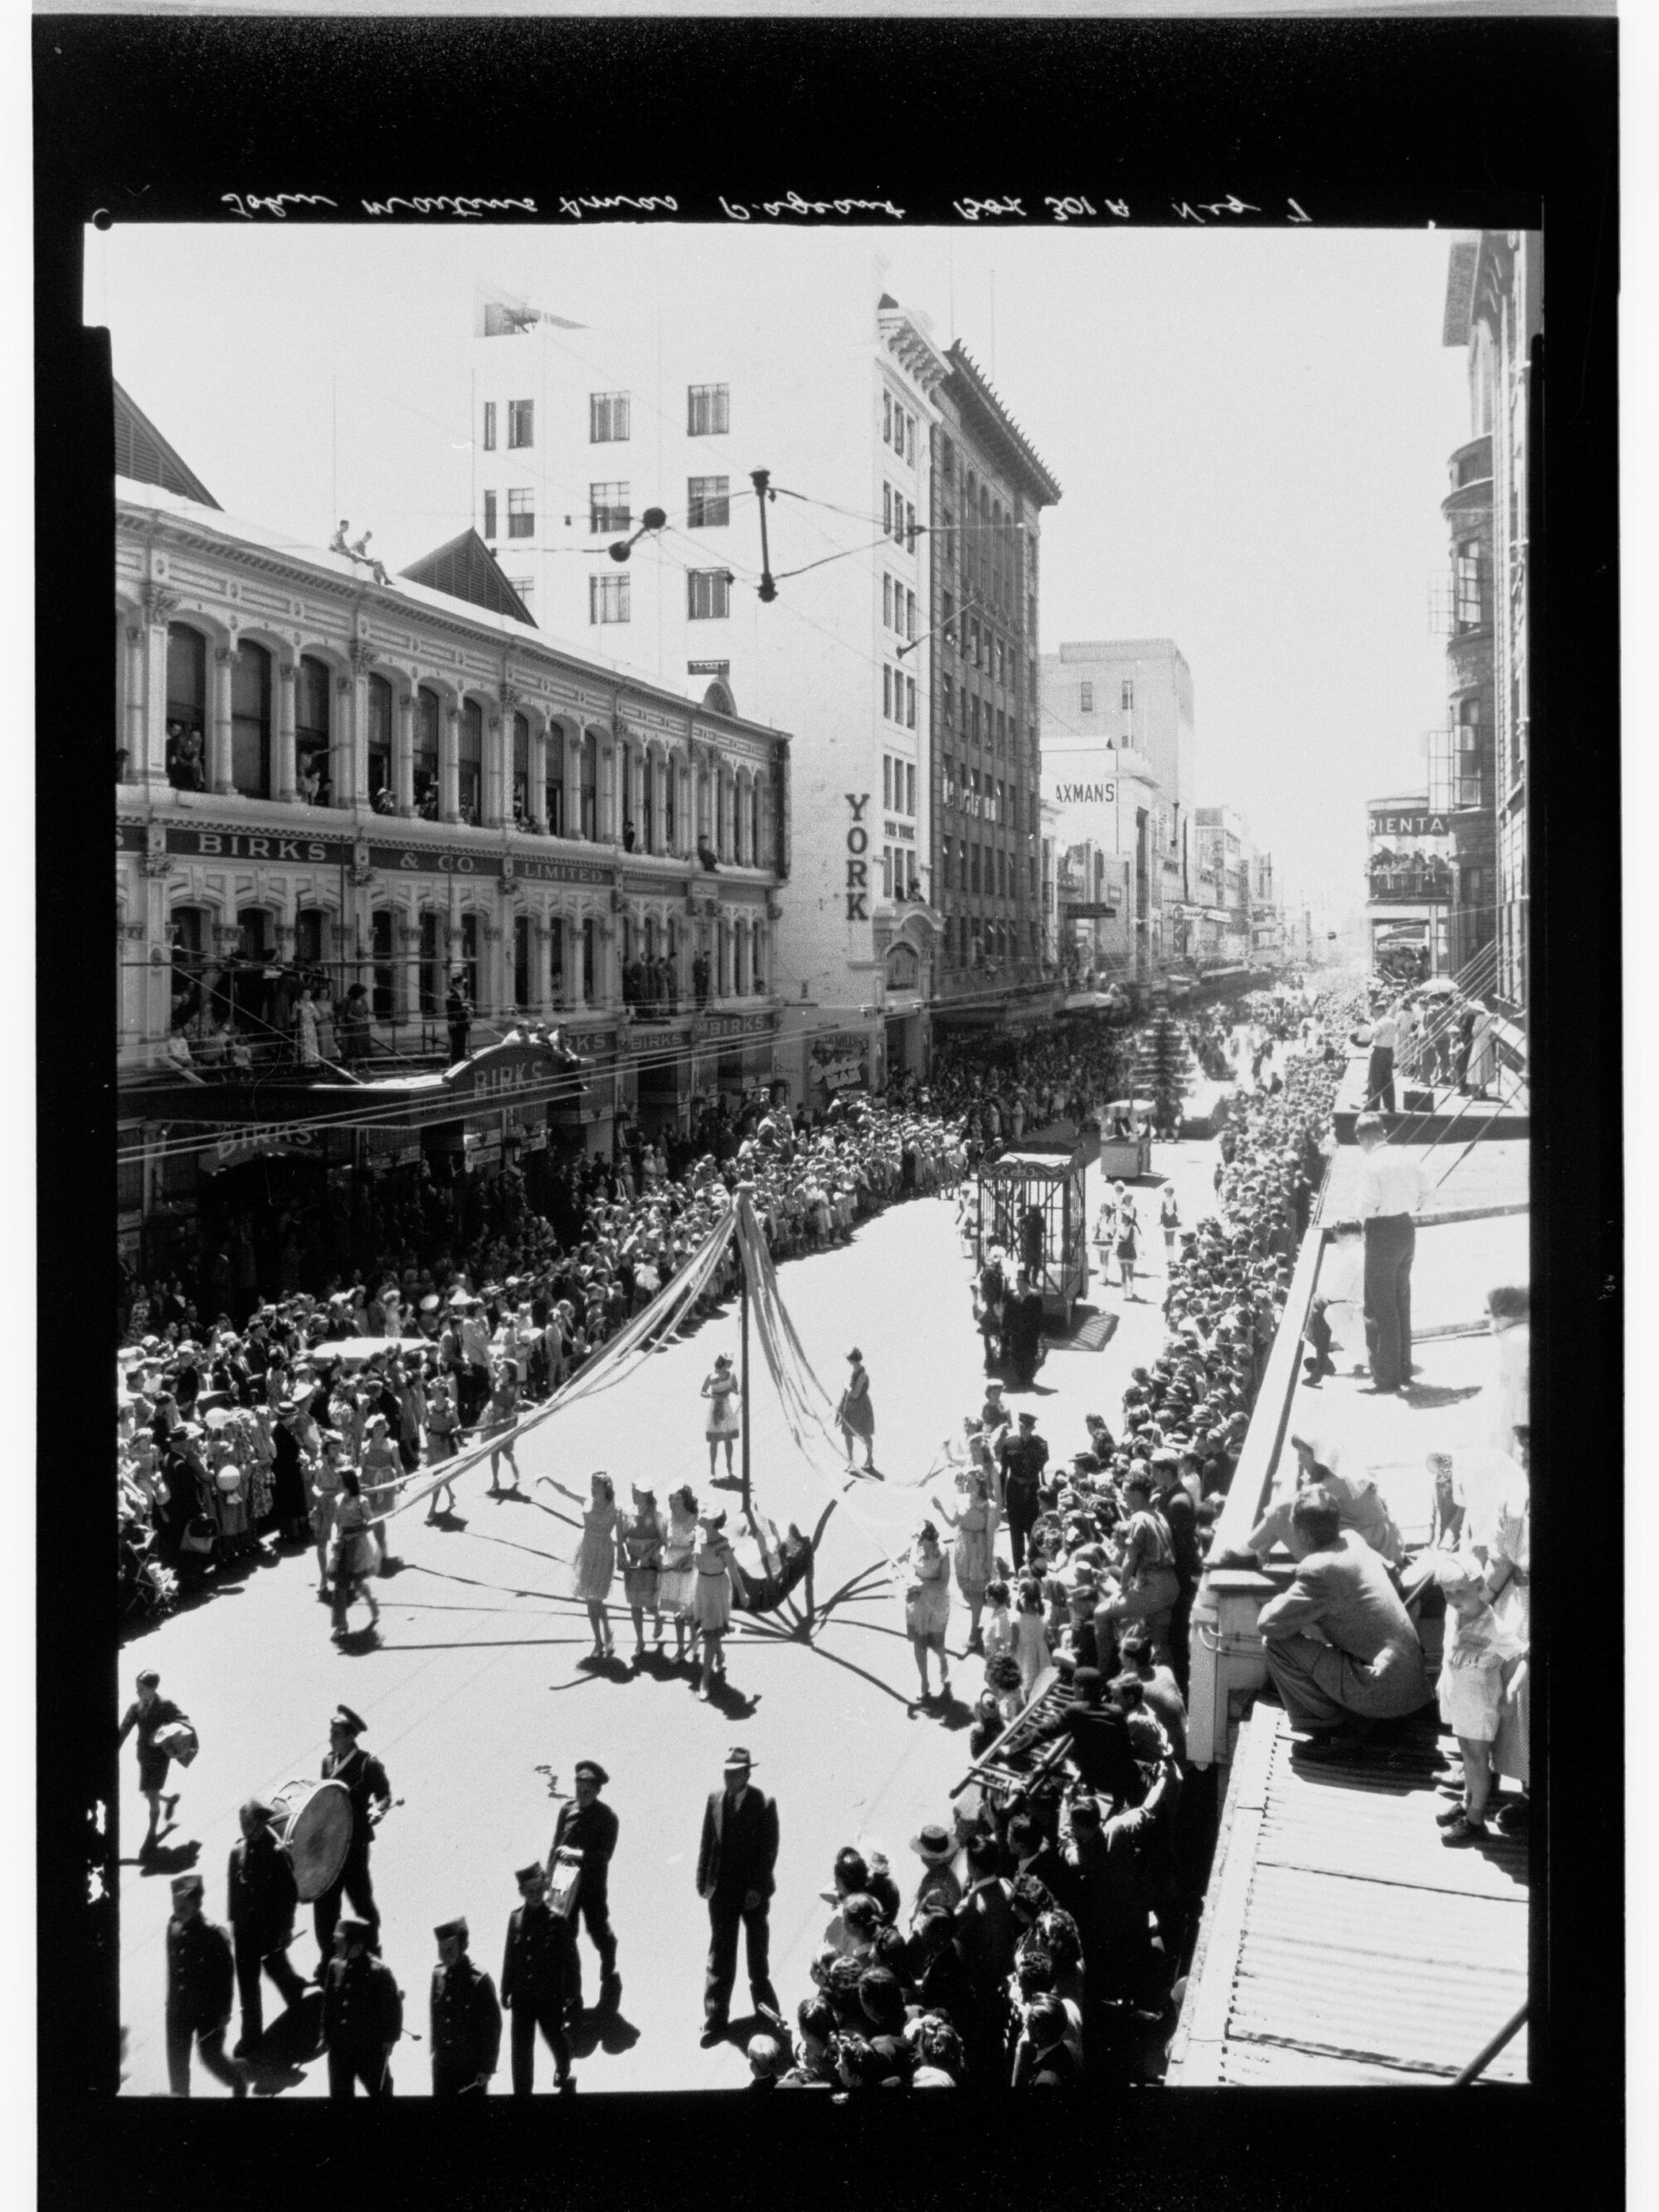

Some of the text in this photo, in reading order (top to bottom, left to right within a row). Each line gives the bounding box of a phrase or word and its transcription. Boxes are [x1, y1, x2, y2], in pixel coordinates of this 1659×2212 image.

[1368, 817, 1450, 834] RIENTA
[198, 833, 328, 861] BIRKS
[400, 851, 420, 870] &
[524, 862, 604, 883] LIMITED
[844, 793, 870, 922] YORK
[710, 1016, 764, 1036] BIRKS
[631, 1033, 683, 1050] BIRKS
[474, 1060, 543, 1099] BIRKS
